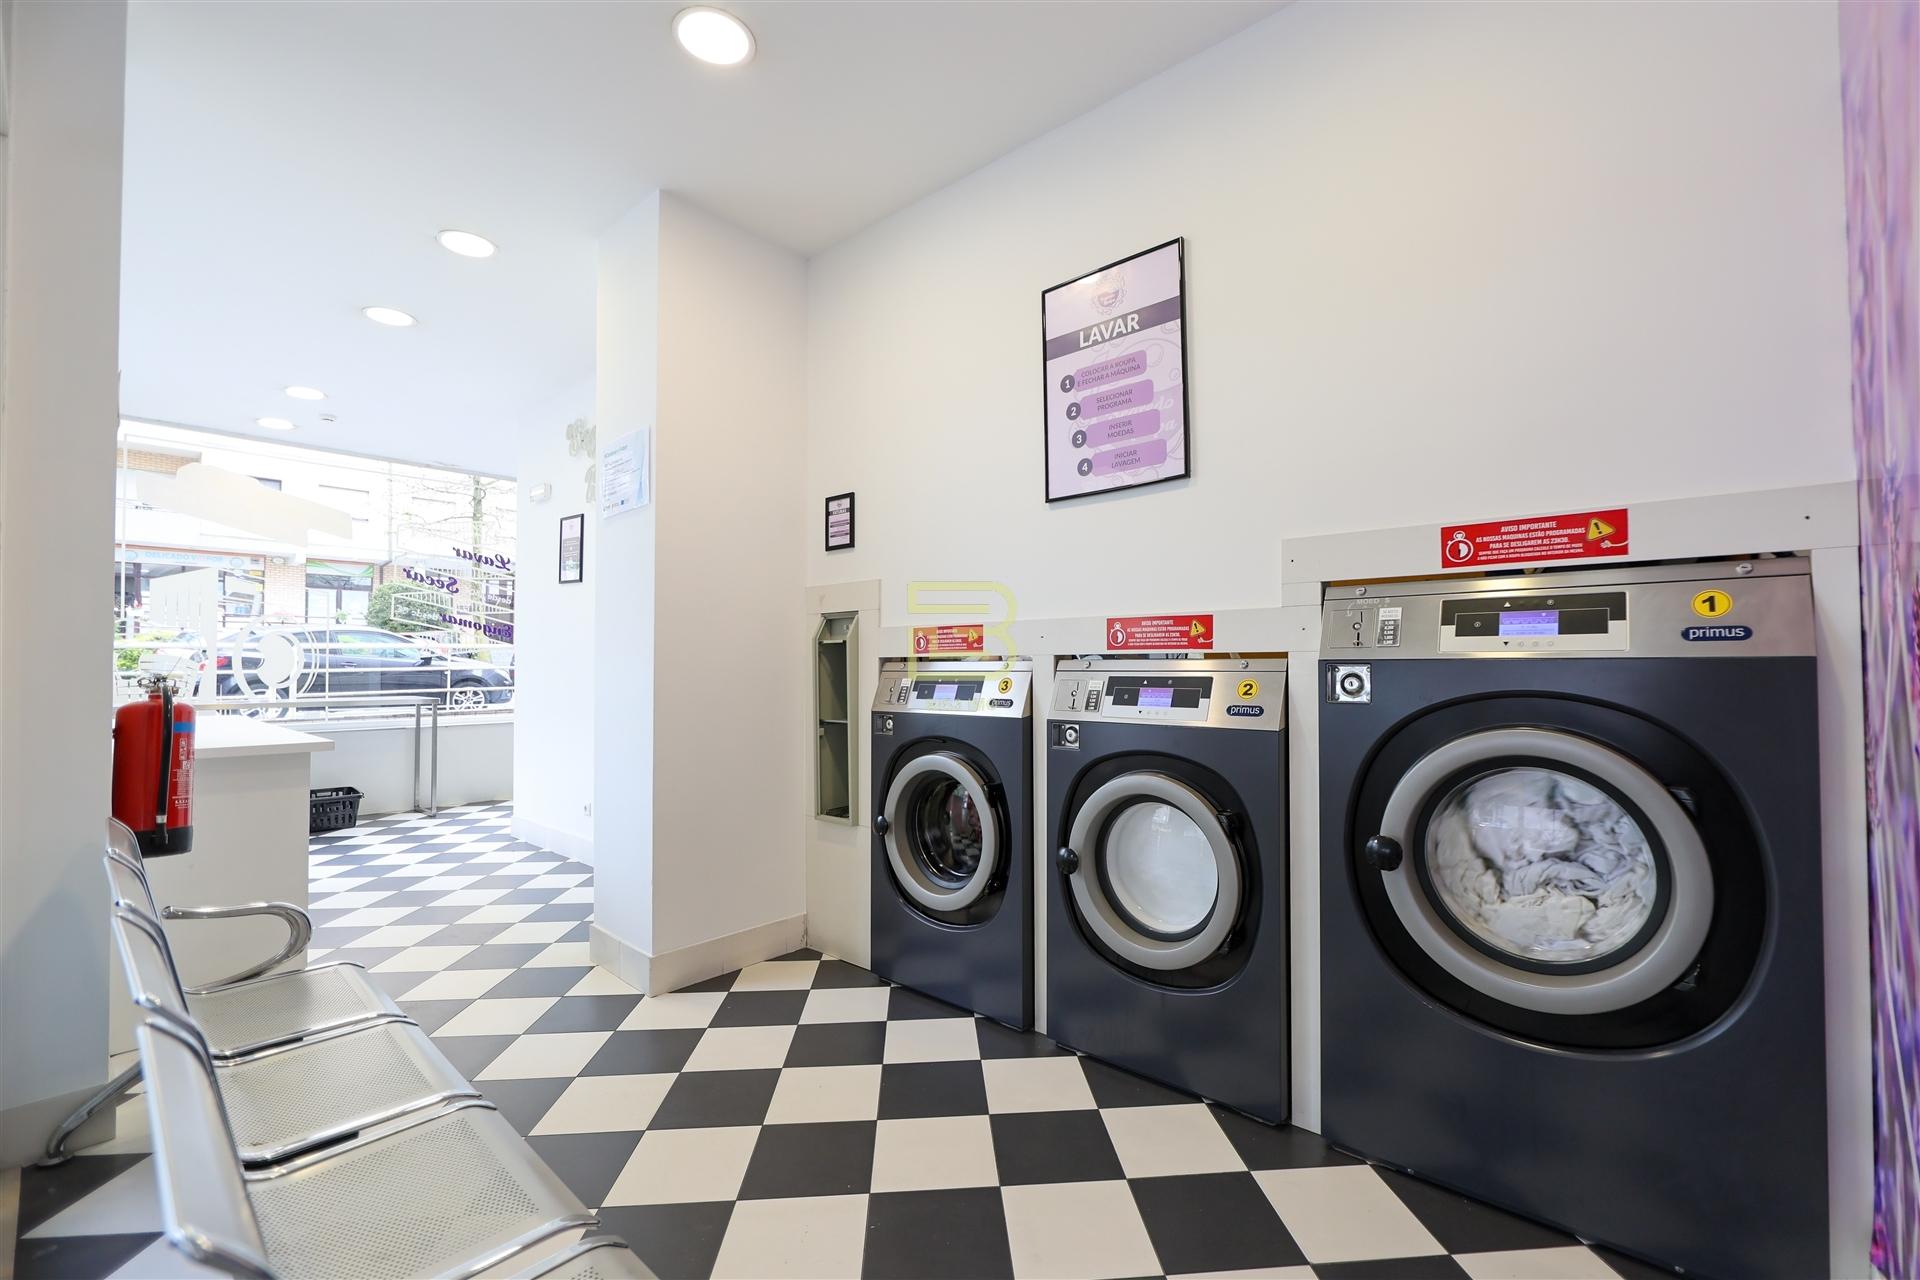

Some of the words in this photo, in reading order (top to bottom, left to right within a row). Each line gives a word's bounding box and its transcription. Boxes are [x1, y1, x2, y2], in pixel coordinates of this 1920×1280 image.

[1080, 313, 1140, 348] LAVAR
[1081, 364, 1109, 378] COLOCAR
[1115, 357, 1136, 368] ROUPA
[1082, 374, 1105, 385] FECHAR
[1111, 363, 1141, 377] MÁQUINA
[1065, 380, 1071, 389] 1
[1096, 389, 1133, 404] SELECIONAR
[1097, 398, 1133, 412] PROGRAMA
[1070, 407, 1077, 417] 2
[1108, 420, 1133, 430] INSERIR
[1076, 434, 1082, 444] 3
[1107, 428, 1135, 439] MOEDAS
[1114, 449, 1137, 460] INICIAR
[1082, 463, 1088, 472] 4
[1111, 458, 1141, 469] LAVAGEM
[1500, 525, 1518, 533] AVISO
[1519, 521, 1557, 531] IMPORTANTE
[1545, 527, 1586, 537] PROGRAMADAS
[1510, 538, 1543, 548] DESLIGAREM
[1702, 595, 1716, 612] 1
[1689, 626, 1746, 640] primus
[1001, 680, 1009, 691] 3
[1242, 683, 1254, 696] 2
[1230, 705, 1260, 715] primus
